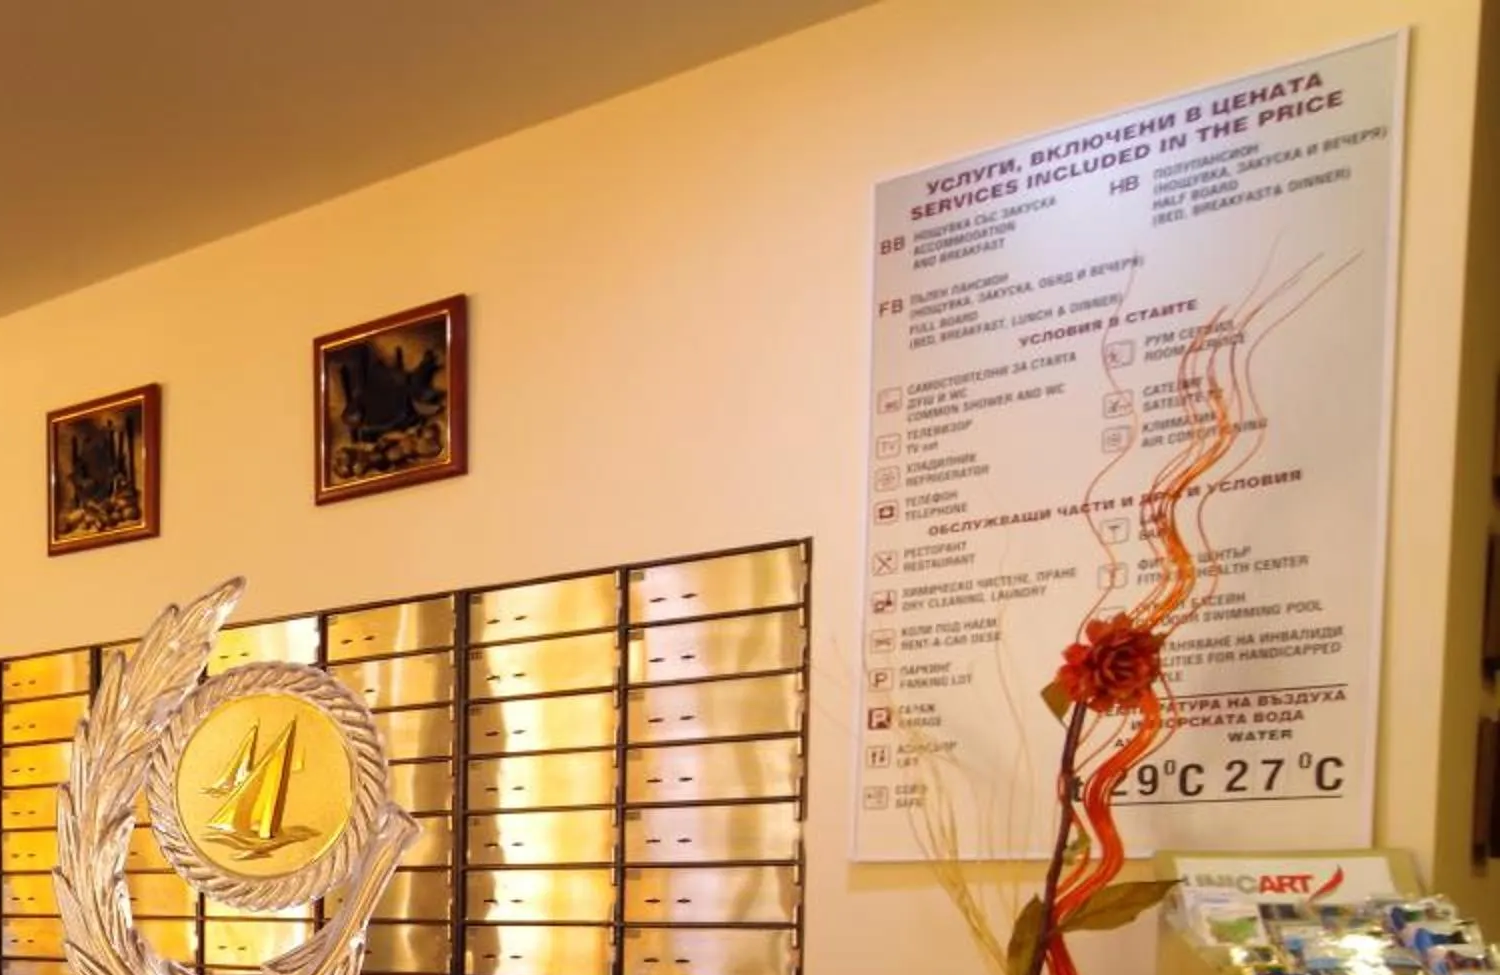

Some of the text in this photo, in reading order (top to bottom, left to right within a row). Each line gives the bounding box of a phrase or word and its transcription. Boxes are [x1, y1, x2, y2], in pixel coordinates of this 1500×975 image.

[927, 72, 1323, 195] УСЛУГИ, ВКЛЮЧЕНИ В ЦЕНАТА
[910, 90, 1343, 221] SERVICES INCLUDED IN THE PRICE
[1190, 180, 1239, 202] BOARD
[1018, 319, 1102, 347] УСЛОВИЯ
[1206, 469, 1303, 495] УСЛОВИЯ
[1228, 696, 1251, 709] НА
[1257, 689, 1347, 708] ВЪЗДУХА
[1253, 709, 1305, 725] ВОДА
[1227, 728, 1293, 743] WATER
